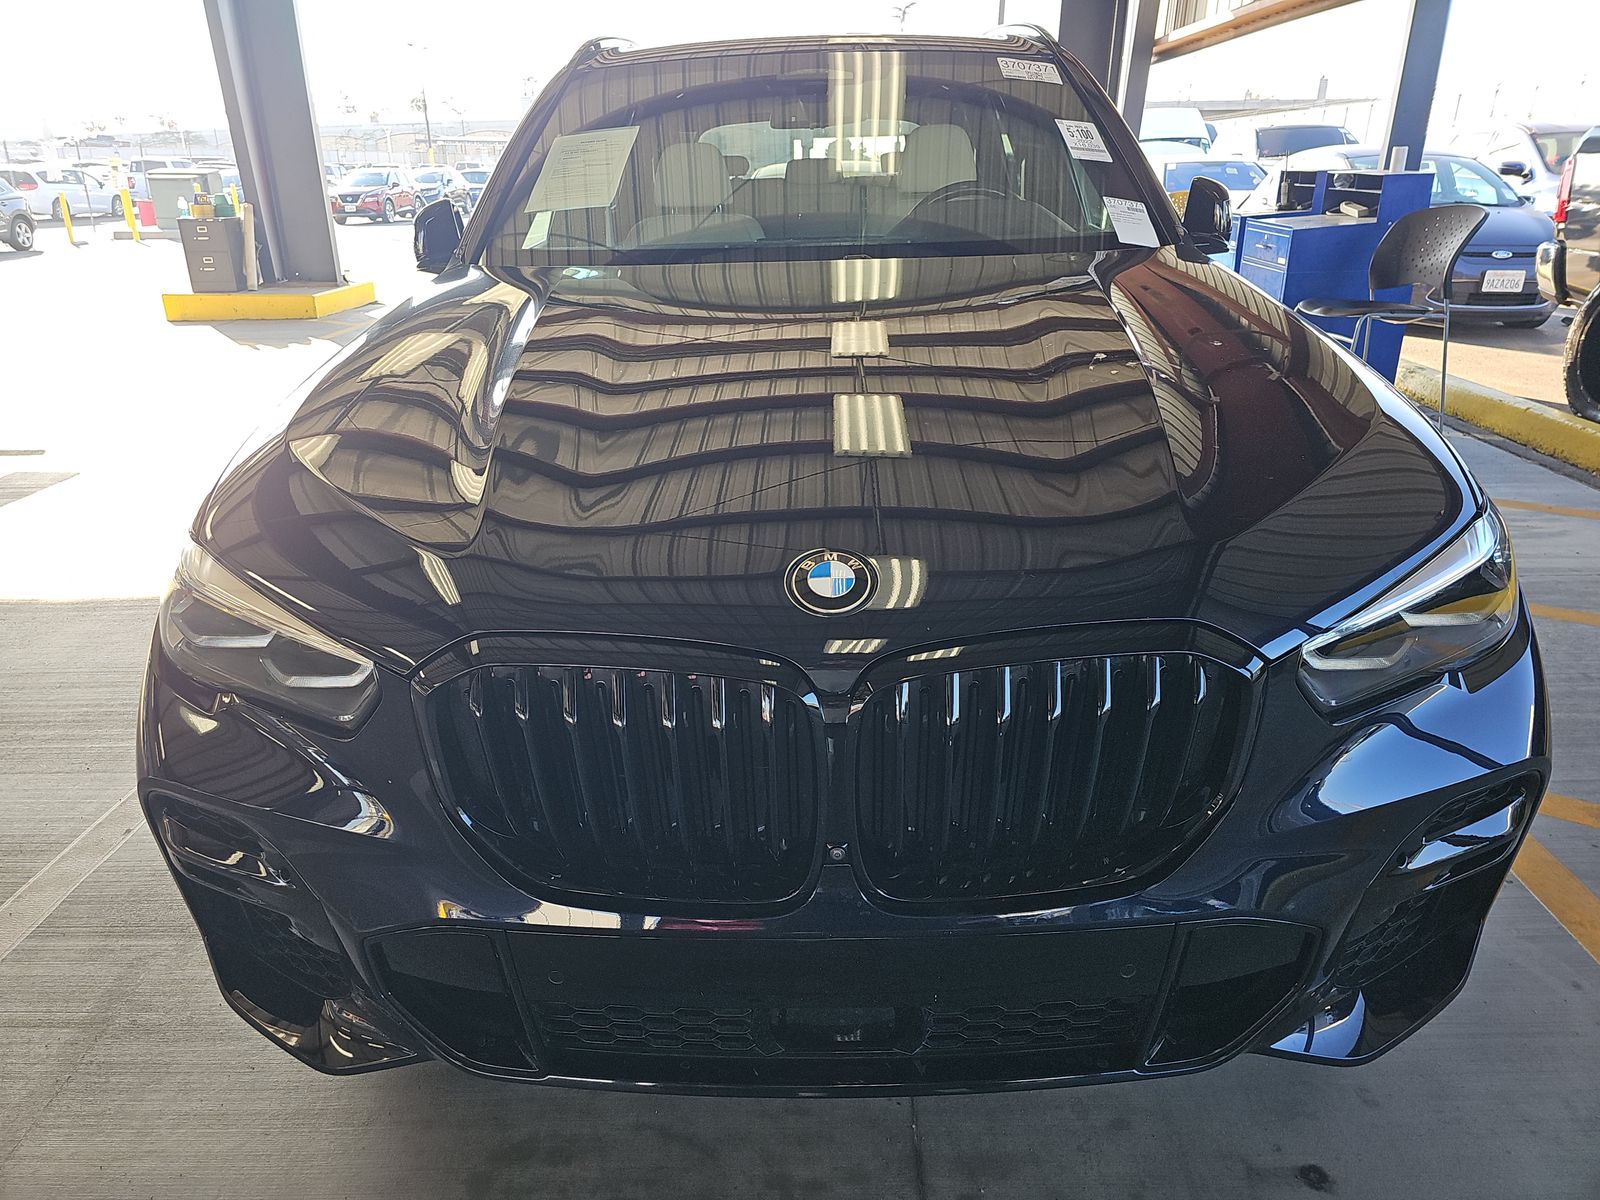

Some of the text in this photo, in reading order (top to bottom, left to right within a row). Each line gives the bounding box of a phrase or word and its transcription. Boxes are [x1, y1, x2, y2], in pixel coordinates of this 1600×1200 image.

[1000, 60, 1056, 74] 3707371
[1066, 127, 1094, 140] 5:100
[1105, 197, 1145, 209] 3707371
[801, 553, 863, 571] BMW
